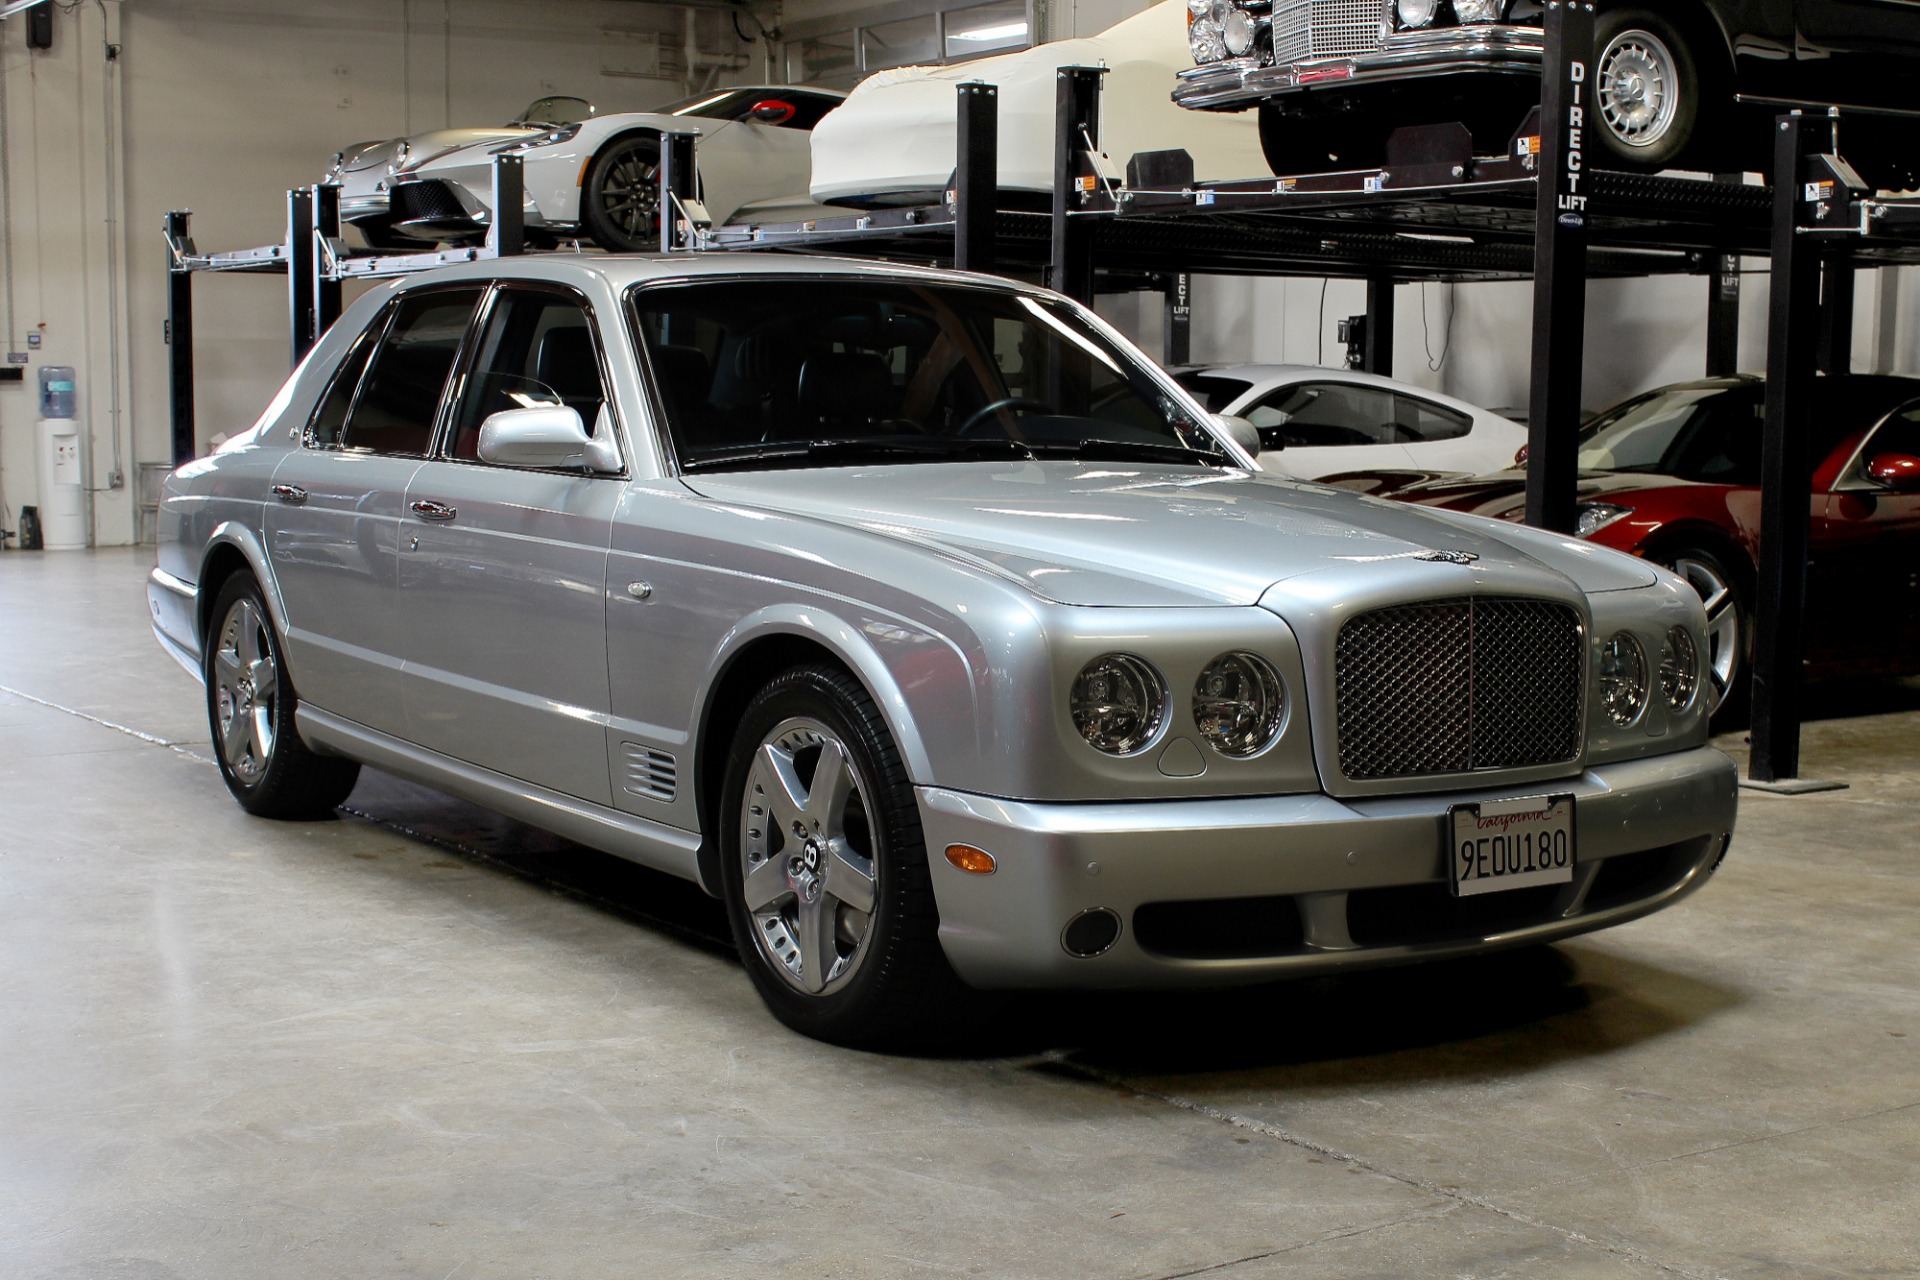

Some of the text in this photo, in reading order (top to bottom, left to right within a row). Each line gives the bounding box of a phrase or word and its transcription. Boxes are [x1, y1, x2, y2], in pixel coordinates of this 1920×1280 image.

[1568, 61, 1585, 193] DIRECT
[1558, 194, 1587, 211] LIFT
[1178, 273, 1186, 306] ECT
[1722, 276, 1739, 287] LIFT
[1173, 305, 1190, 314] LIFT
[804, 843, 817, 869] B
